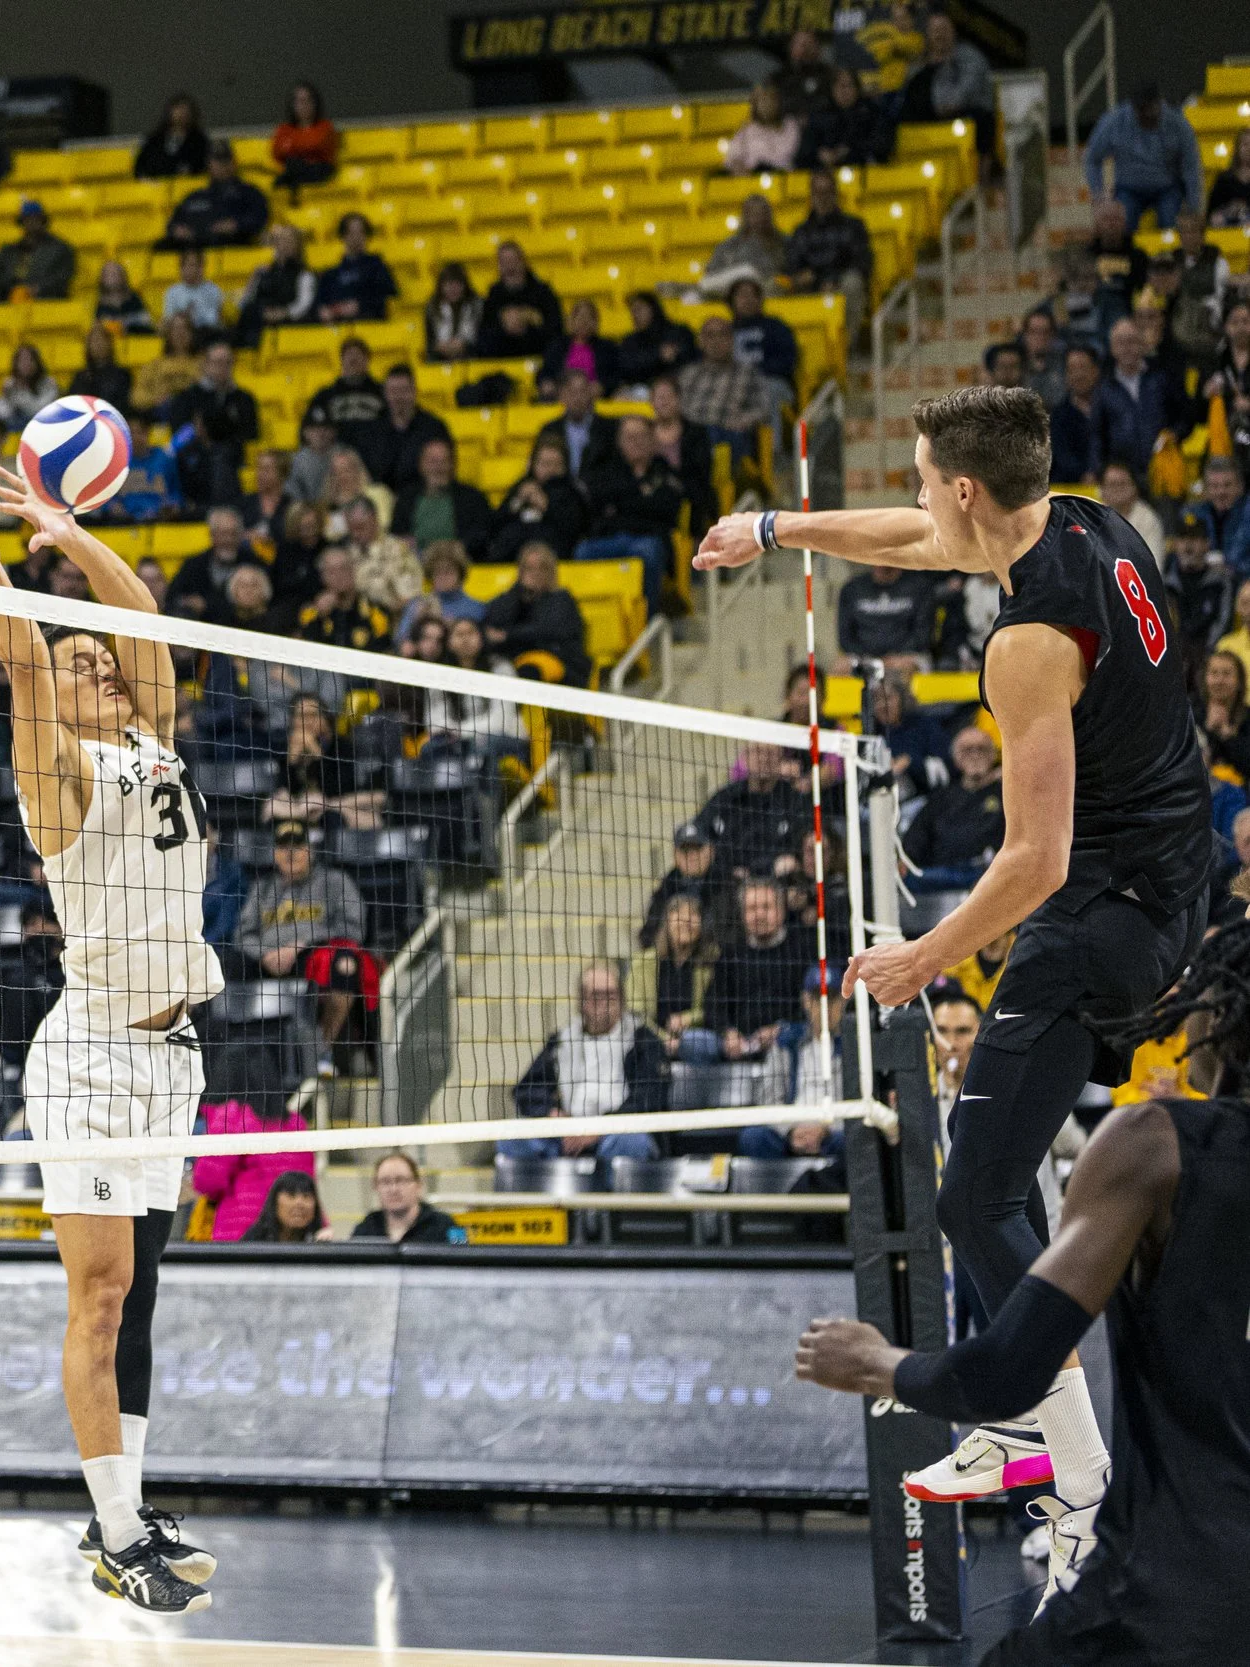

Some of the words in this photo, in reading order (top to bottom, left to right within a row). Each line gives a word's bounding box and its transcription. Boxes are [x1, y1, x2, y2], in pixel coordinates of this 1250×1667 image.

[463, 20, 545, 58] LONG
[552, 10, 650, 51] BEACH
[658, 2, 754, 42] STATE
[1114, 558, 1167, 668] 8
